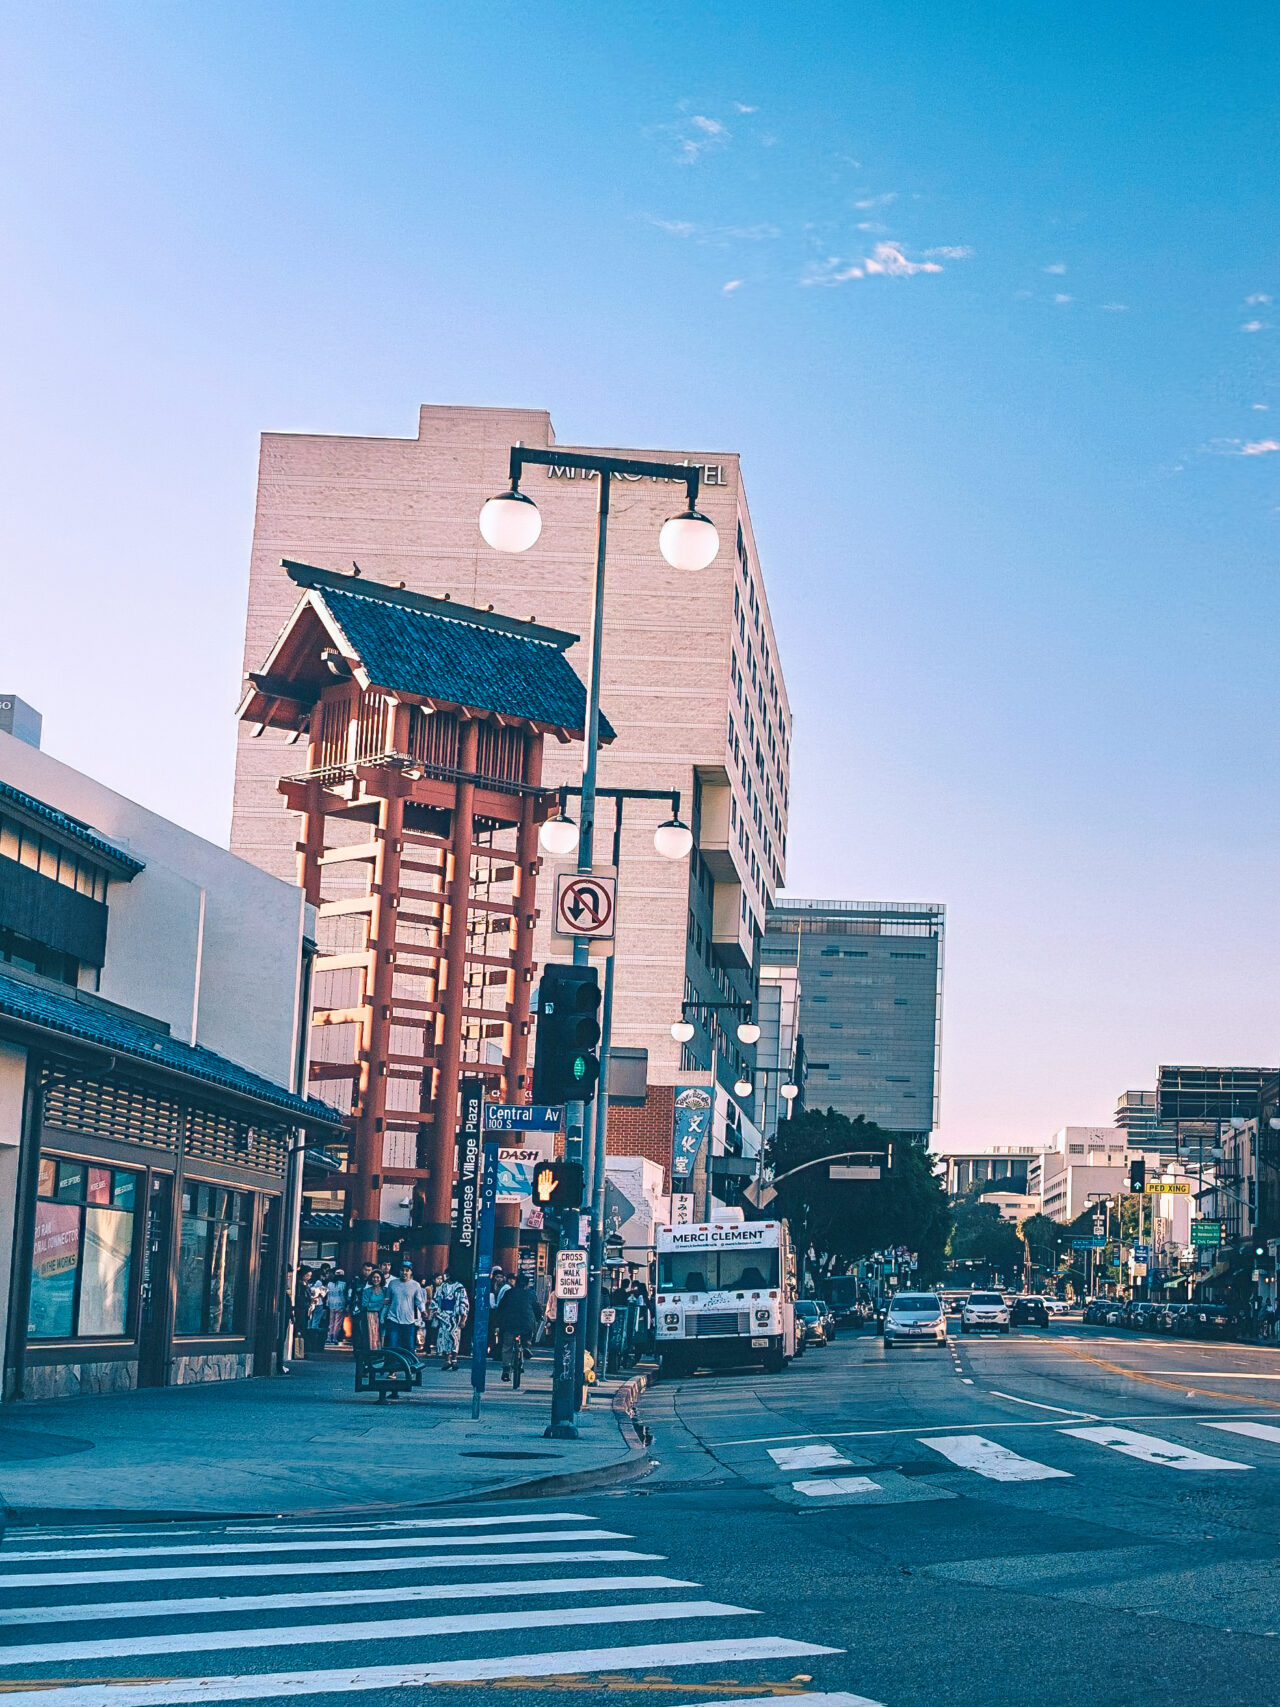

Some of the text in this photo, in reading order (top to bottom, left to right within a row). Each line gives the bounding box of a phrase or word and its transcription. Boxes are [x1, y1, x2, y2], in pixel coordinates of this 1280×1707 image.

[489, 1107, 559, 1121] Central Av
[489, 1120, 512, 1128] 100 S
[675, 1115, 704, 1174] 文化堂
[499, 1150, 539, 1161] DASH
[460, 1099, 478, 1247] Japanese Village Plaza
[486, 1153, 495, 1209] LADOT
[1168, 1185, 1187, 1193] XING
[672, 1230, 764, 1243] MERCI CLEMENT
[561, 1253, 583, 1261] CROSS
[563, 1269, 580, 1277] WALK
[560, 1278, 582, 1286] SIGNAL
[563, 1287, 580, 1295] ONLY
